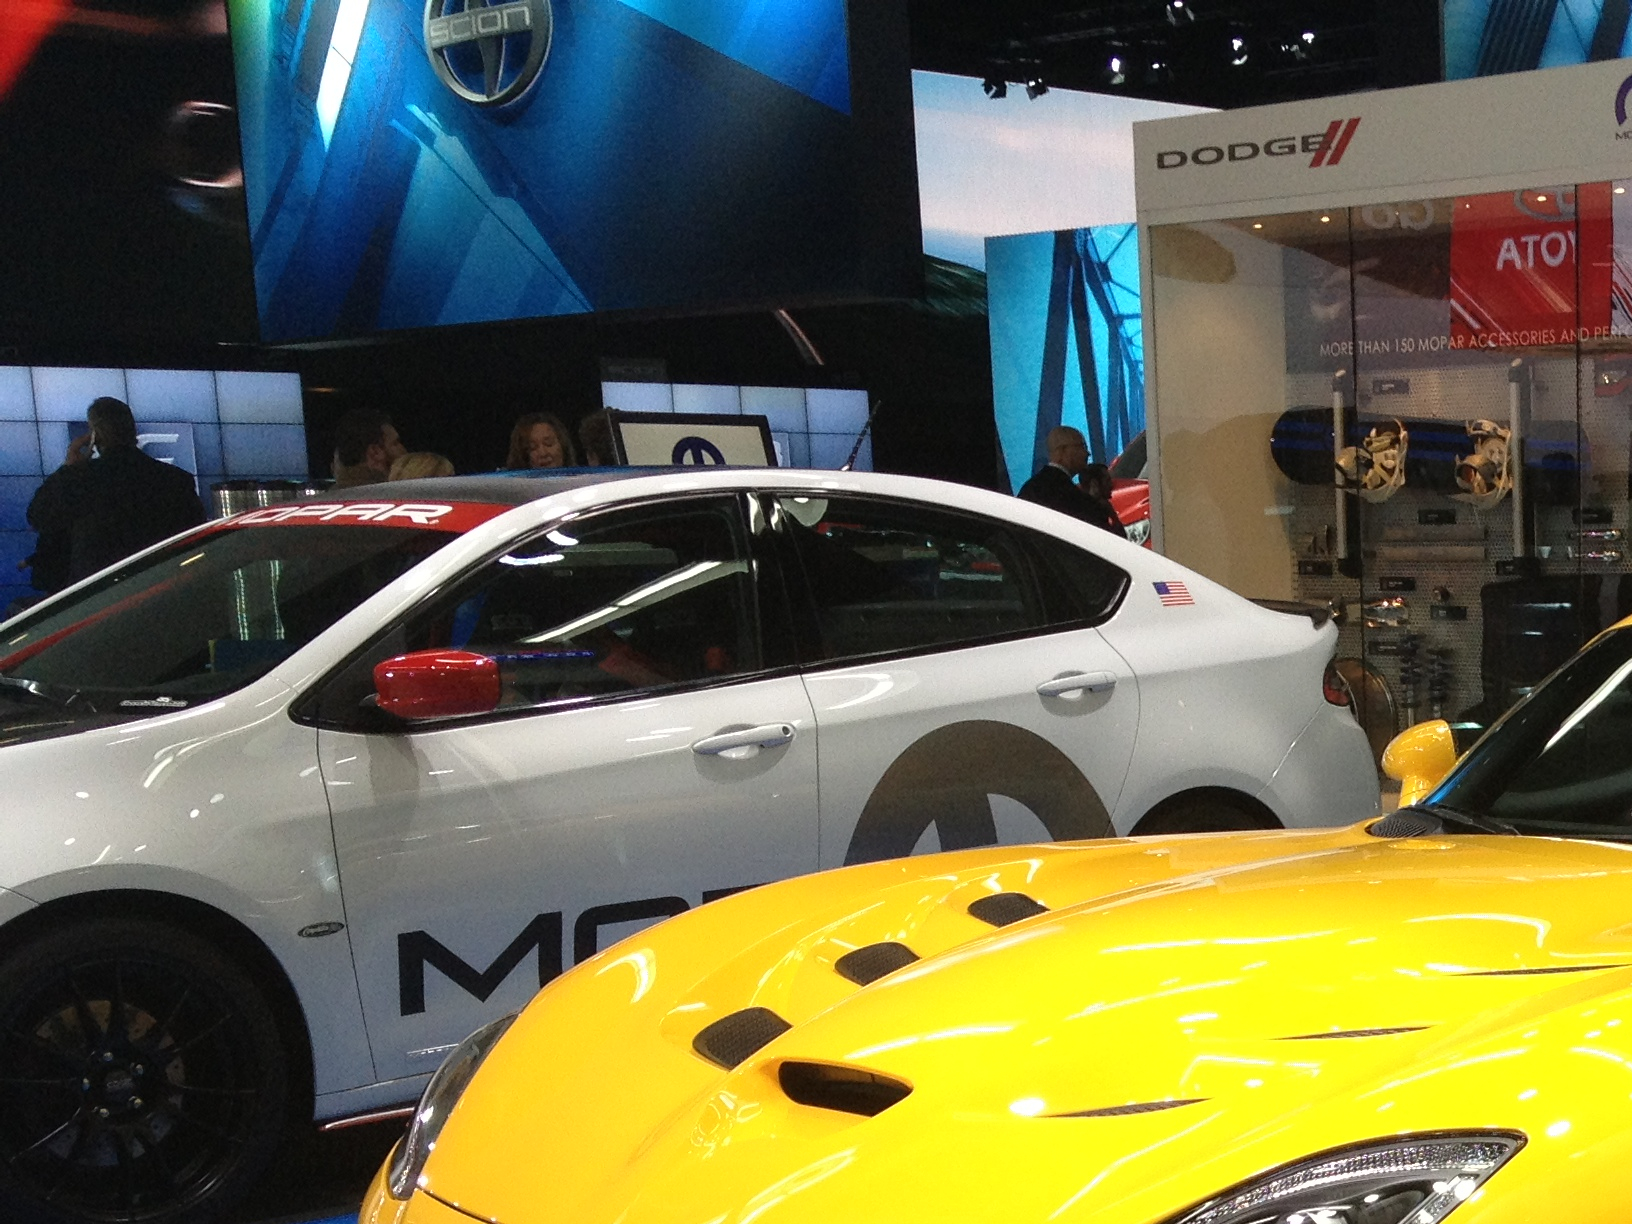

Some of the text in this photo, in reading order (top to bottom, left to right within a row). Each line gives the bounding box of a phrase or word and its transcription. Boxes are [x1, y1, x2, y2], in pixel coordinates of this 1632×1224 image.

[1157, 132, 1332, 170] DODGE
[1319, 341, 1354, 356] MORE
[1358, 340, 1390, 354] THAN
[1394, 338, 1415, 353] 150
[1418, 335, 1464, 351] MOPAR
[1469, 328, 1556, 349] ACCESSORIES
[1560, 326, 1590, 343] AND
